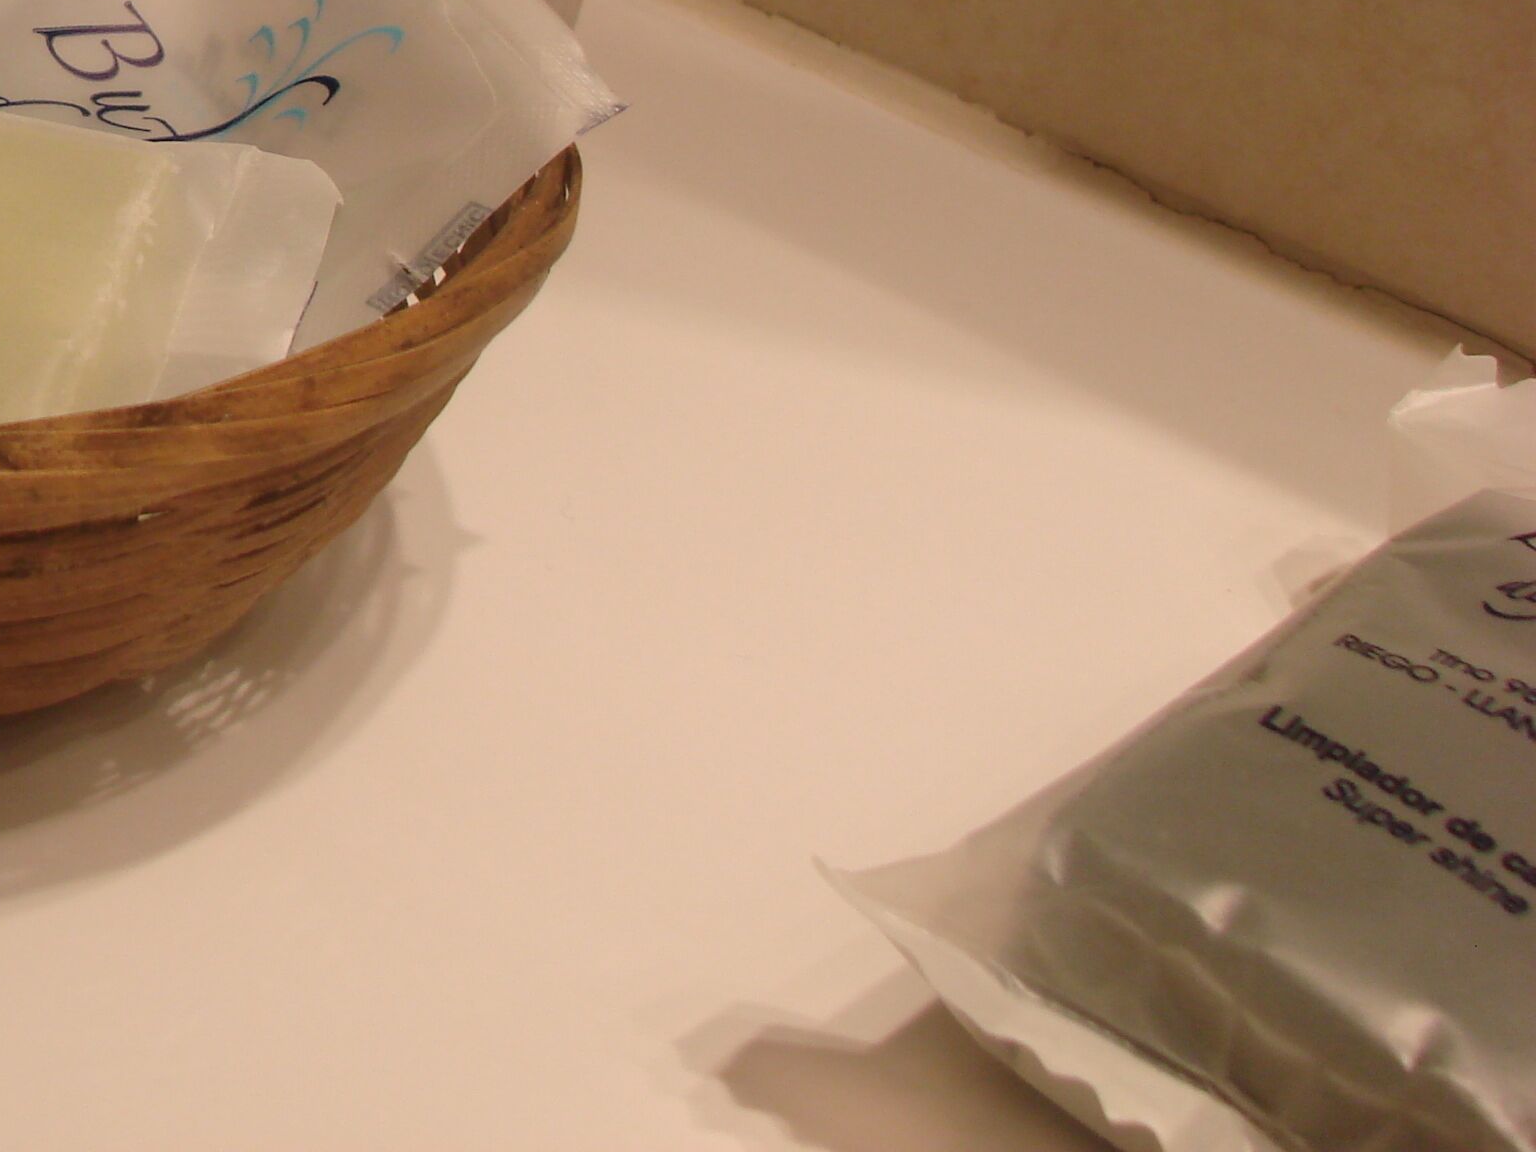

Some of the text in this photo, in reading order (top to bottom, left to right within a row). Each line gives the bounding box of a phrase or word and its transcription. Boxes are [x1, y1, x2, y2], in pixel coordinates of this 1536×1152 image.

[1334, 633, 1440, 684] RIEGO
[1258, 704, 1445, 817] Limpiador
[1445, 814, 1497, 851] de
[1321, 777, 1529, 916] Super shine
